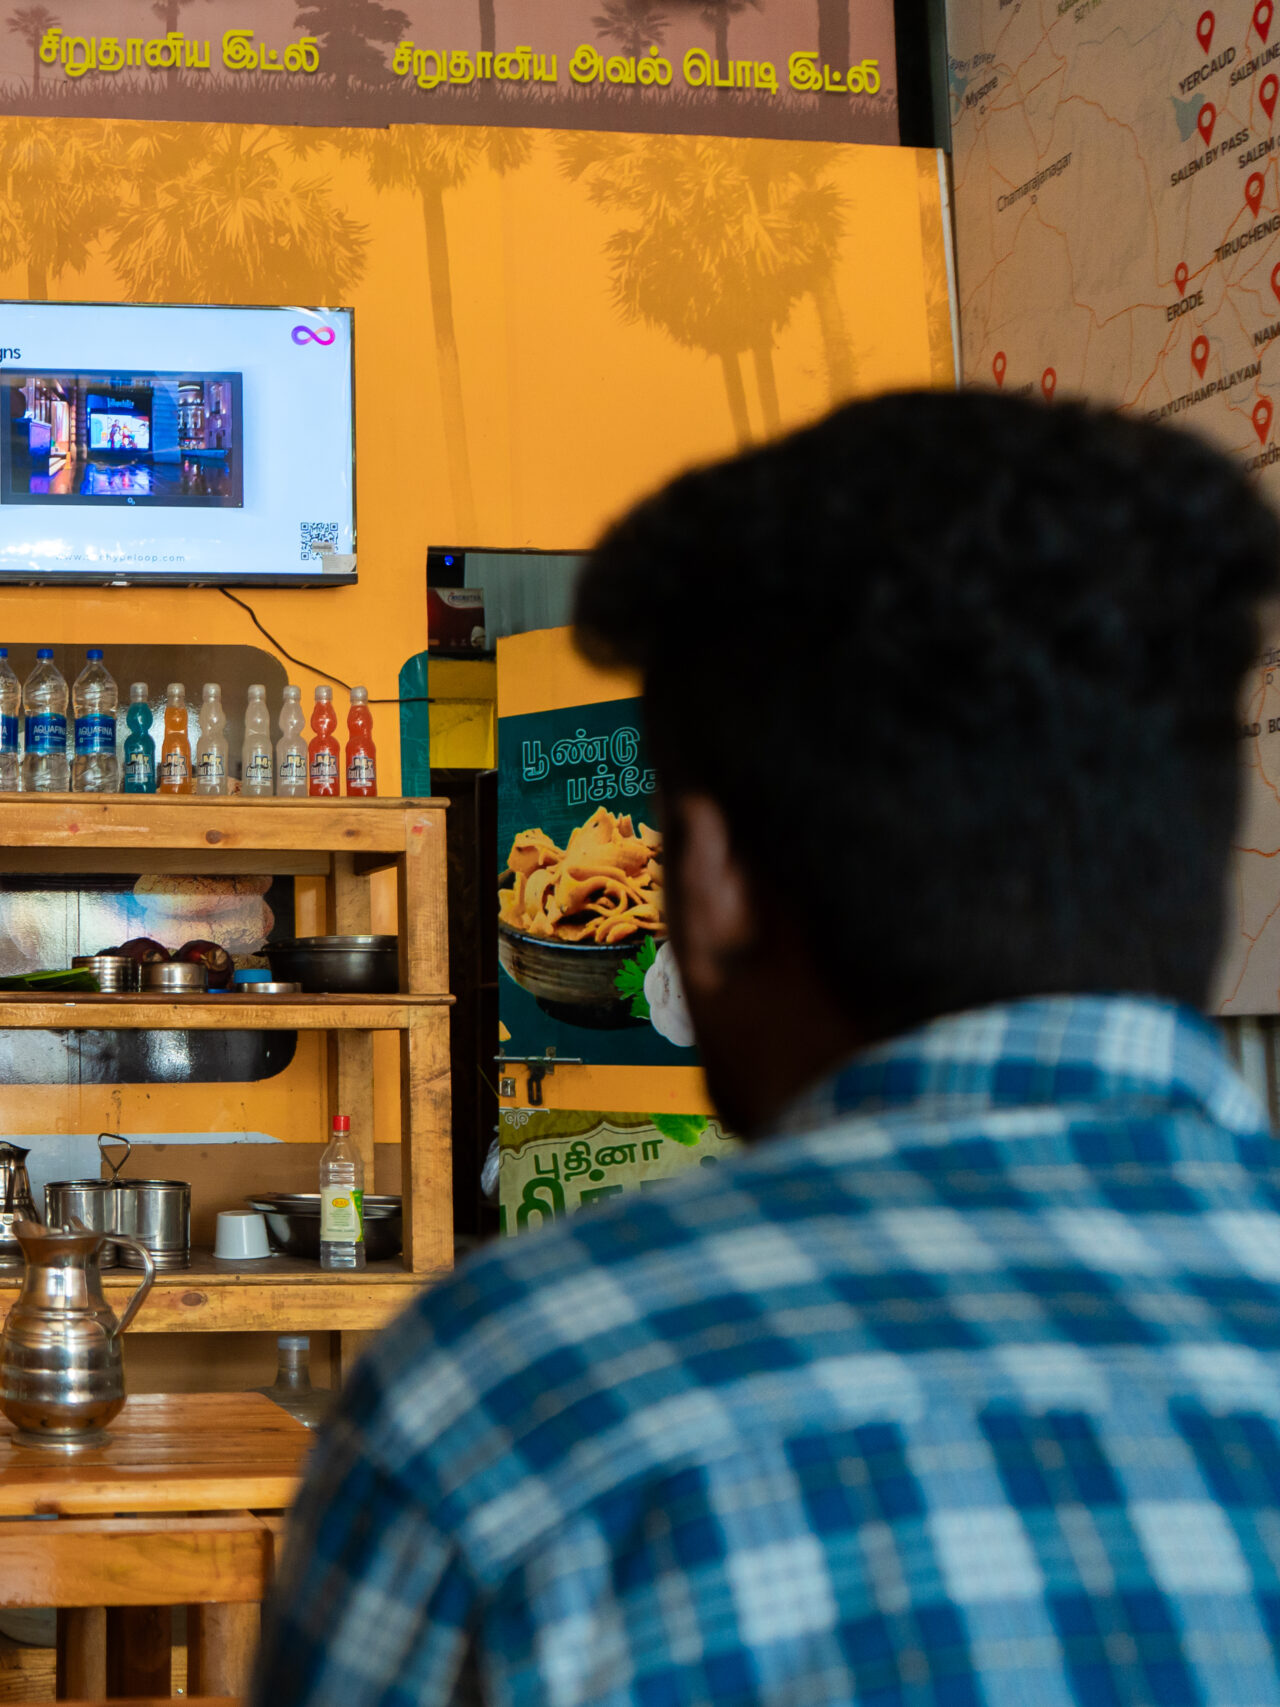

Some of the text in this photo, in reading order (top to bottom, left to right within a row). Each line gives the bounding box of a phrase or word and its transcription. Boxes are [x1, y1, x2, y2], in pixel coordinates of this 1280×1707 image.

[39, 28, 320, 77] சிறுதானிய இட்லி
[392, 41, 880, 94] சிறுதானிய அவல் பொடி இட்லி
[1178, 47, 1236, 95] YERCAUD
[1230, 57, 1261, 87] SALEM
[1171, 157, 1204, 186] SALEM
[1205, 146, 1220, 166] BY
[1221, 128, 1250, 155] PASS
[1238, 136, 1275, 169] SALEM
[1167, 290, 1204, 322] ERODE
[78, 726, 113, 737] AQUAFINA
[522, 727, 640, 782] பூண்டு
[535, 1139, 663, 1182] புதினா
